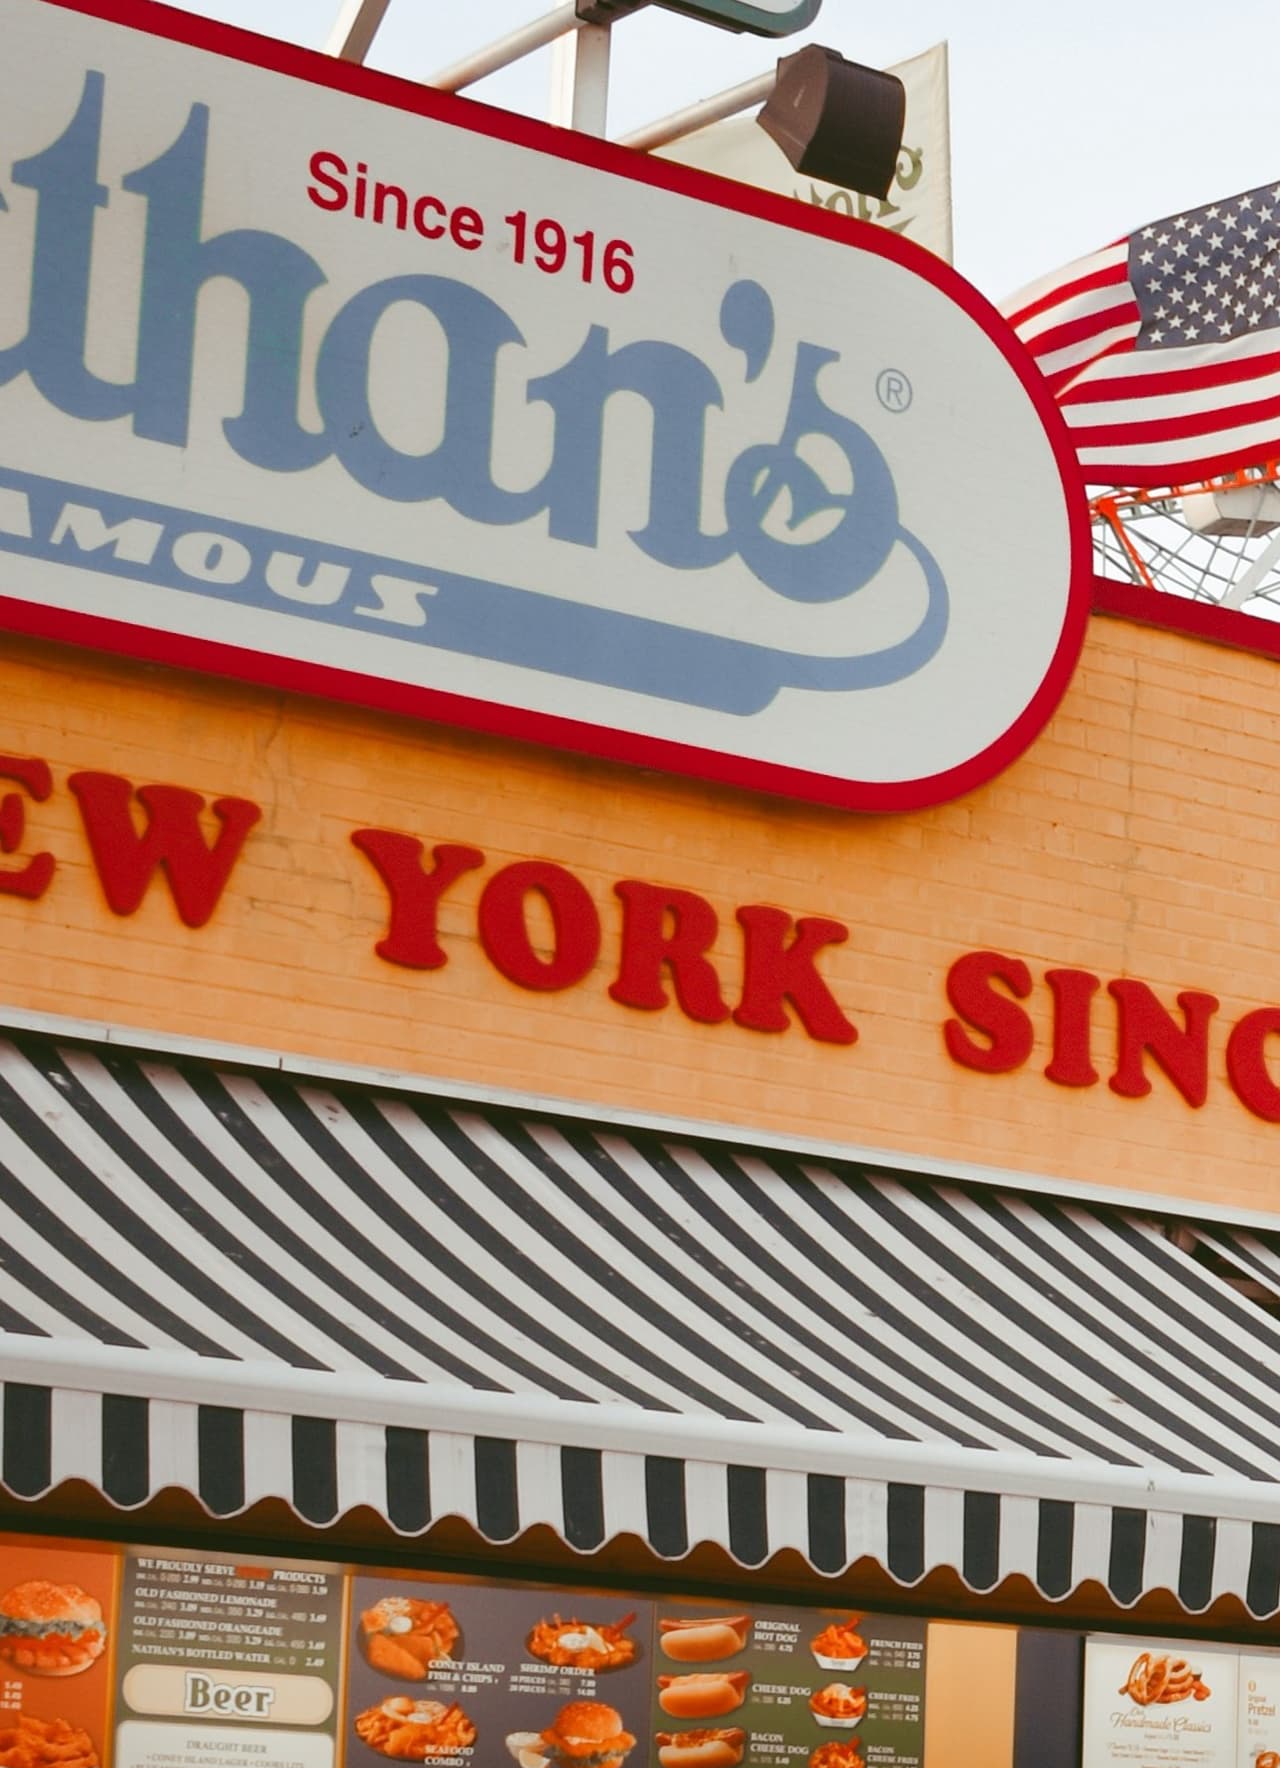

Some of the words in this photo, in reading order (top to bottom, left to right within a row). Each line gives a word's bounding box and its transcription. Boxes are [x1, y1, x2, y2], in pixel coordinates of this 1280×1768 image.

[307, 150, 485, 252] Since
[504, 211, 635, 295] 1916
[351, 827, 860, 1046] YORK
[156, 1560, 203, 1574] PROUDLY
[204, 1564, 235, 1576] SERVE
[273, 1570, 326, 1584] PRODUCTS
[135, 1588, 158, 1597] OLD
[160, 1590, 218, 1603] FASHIONED
[220, 1594, 277, 1608] LEMONADE
[134, 1616, 156, 1626] OLD
[158, 1618, 217, 1631] FASHIONED
[218, 1622, 282, 1636] ORANGEADE
[755, 1620, 801, 1632] ORIGINAL
[754, 1632, 774, 1641] HOT
[776, 1633, 797, 1643] DOG
[870, 1639, 901, 1649] FRENCH
[902, 1642, 923, 1650] FRIES
[132, 1645, 186, 1657] NATHAN'S
[186, 1647, 232, 1661] BOTTLED
[235, 1652, 270, 1663] WATER
[466, 1662, 504, 1672] ISLAND
[520, 1663, 557, 1674] SHRIMP
[560, 1666, 594, 1676] ORDER
[428, 1671, 451, 1680] FISH
[463, 1673, 492, 1683] CHIPS
[185, 1672, 273, 1716] Beer
[752, 1684, 788, 1695] CHEESE
[789, 1685, 812, 1696] DOG
[868, 1692, 897, 1700] CHEESE
[899, 1694, 920, 1702] FRIES
[1248, 1703, 1276, 1716] Pretzel
[751, 1733, 783, 1743] BACON
[186, 1740, 238, 1752] DRAUGHT
[241, 1744, 266, 1753] BEER
[751, 1744, 786, 1754] CHEESE
[787, 1745, 809, 1755] DOG
[897, 1756, 918, 1764] FRIES
